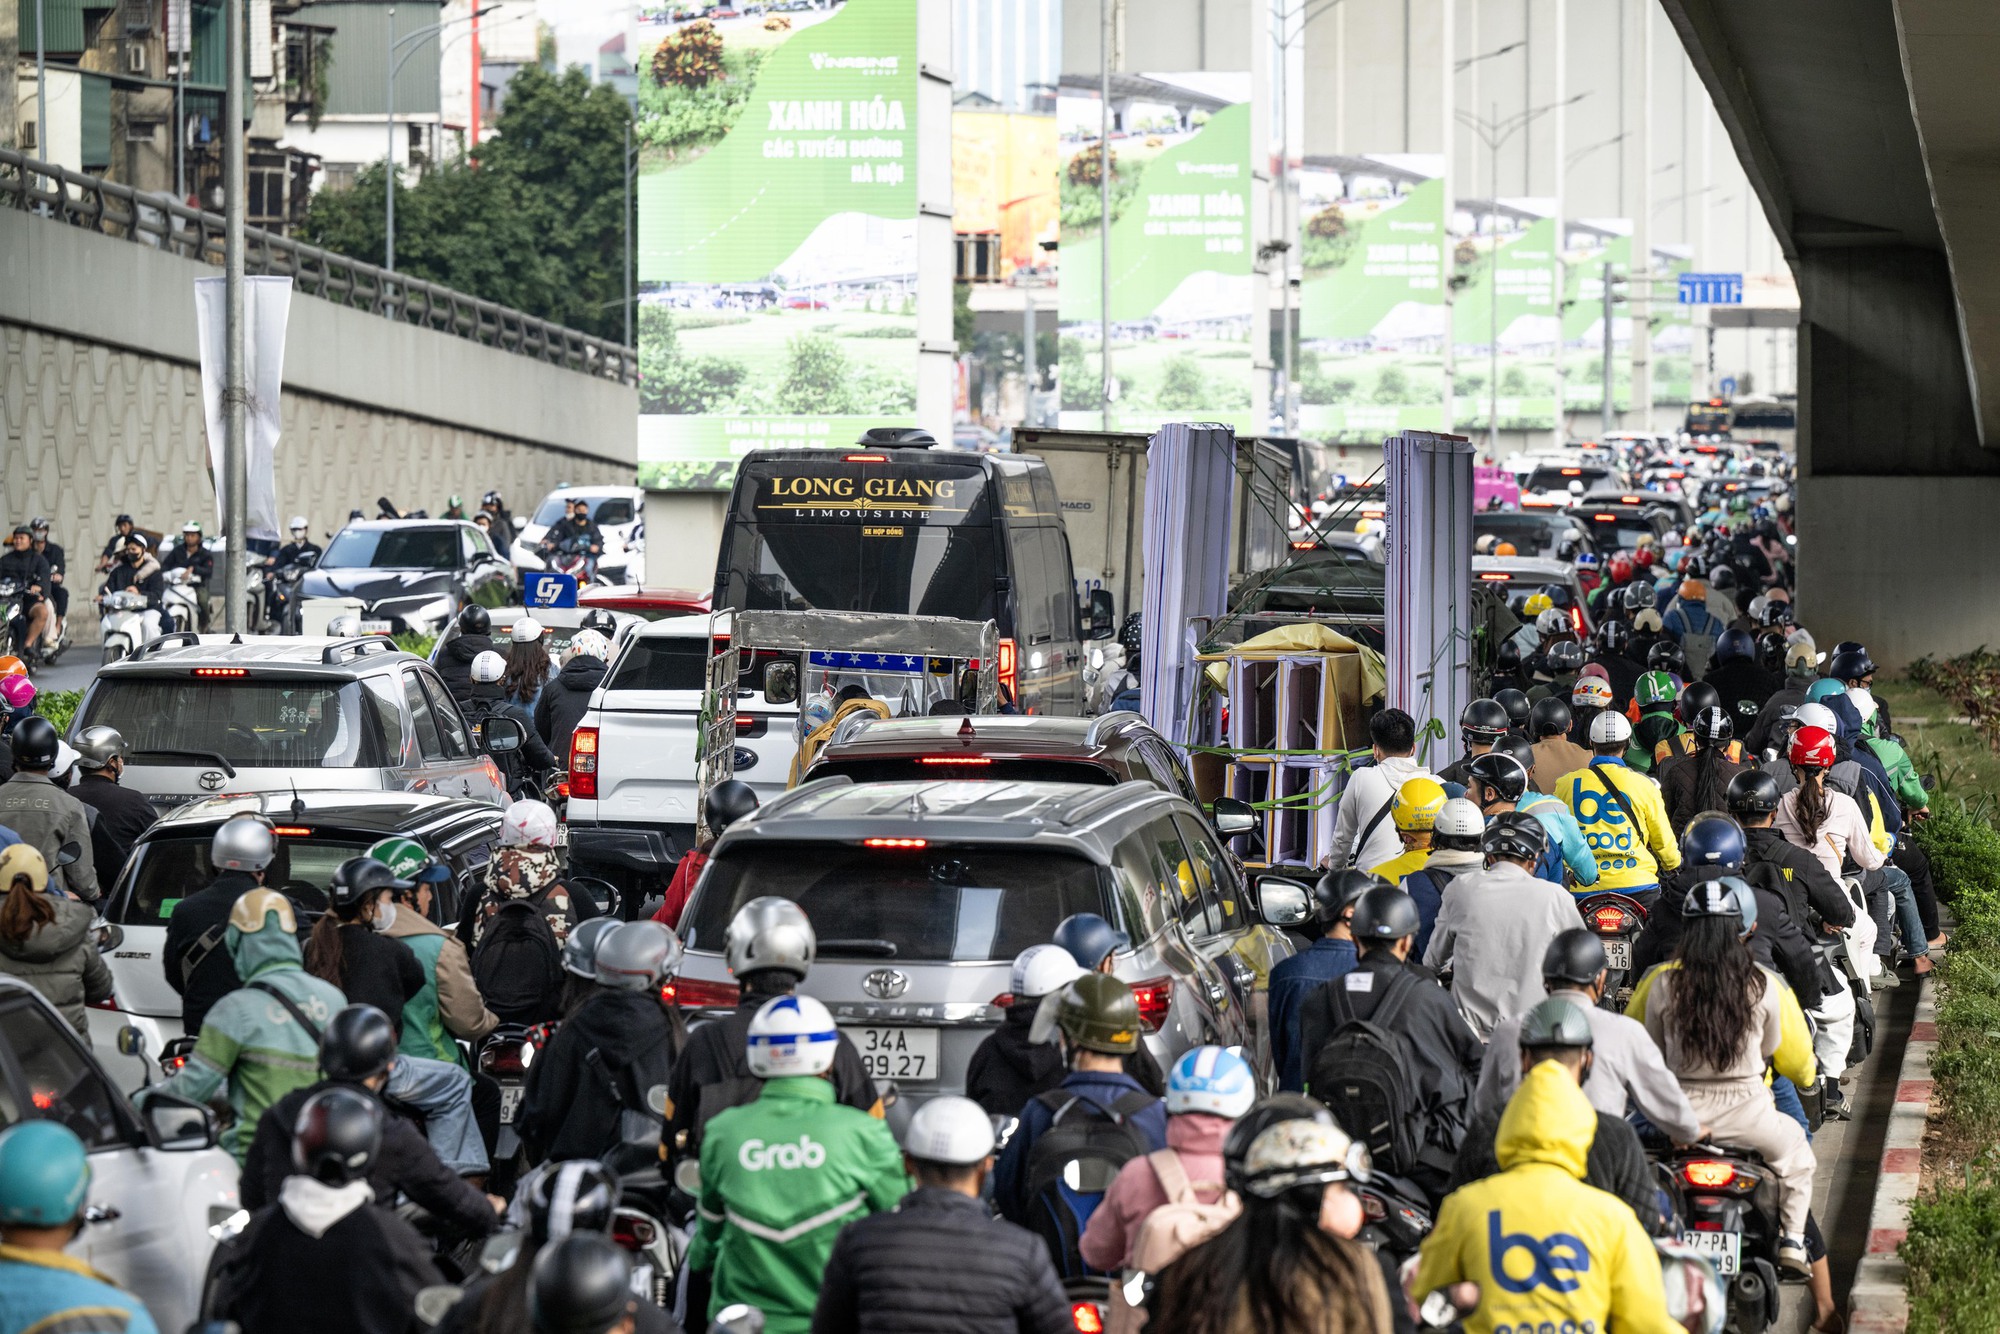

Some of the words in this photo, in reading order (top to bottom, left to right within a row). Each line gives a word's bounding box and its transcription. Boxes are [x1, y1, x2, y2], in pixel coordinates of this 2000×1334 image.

[768, 100, 842, 130] XANH
[850, 94, 906, 130] HÓA
[762, 137, 795, 158] CÁC
[797, 135, 847, 158] TUYẾN
[851, 162, 873, 183] HÀ
[876, 161, 904, 186] NỘI
[772, 477, 853, 496] LONG
[865, 478, 956, 498] GIANG
[795, 509, 930, 519] LIMOUSINE
[536, 577, 563, 604] G7
[1572, 778, 1632, 825] be
[389, 857, 417, 877] rab
[266, 994, 329, 1025] Gab
[865, 1030, 907, 1051] 34A
[738, 1134, 826, 1171] Grab
[1488, 1210, 1590, 1294] be
